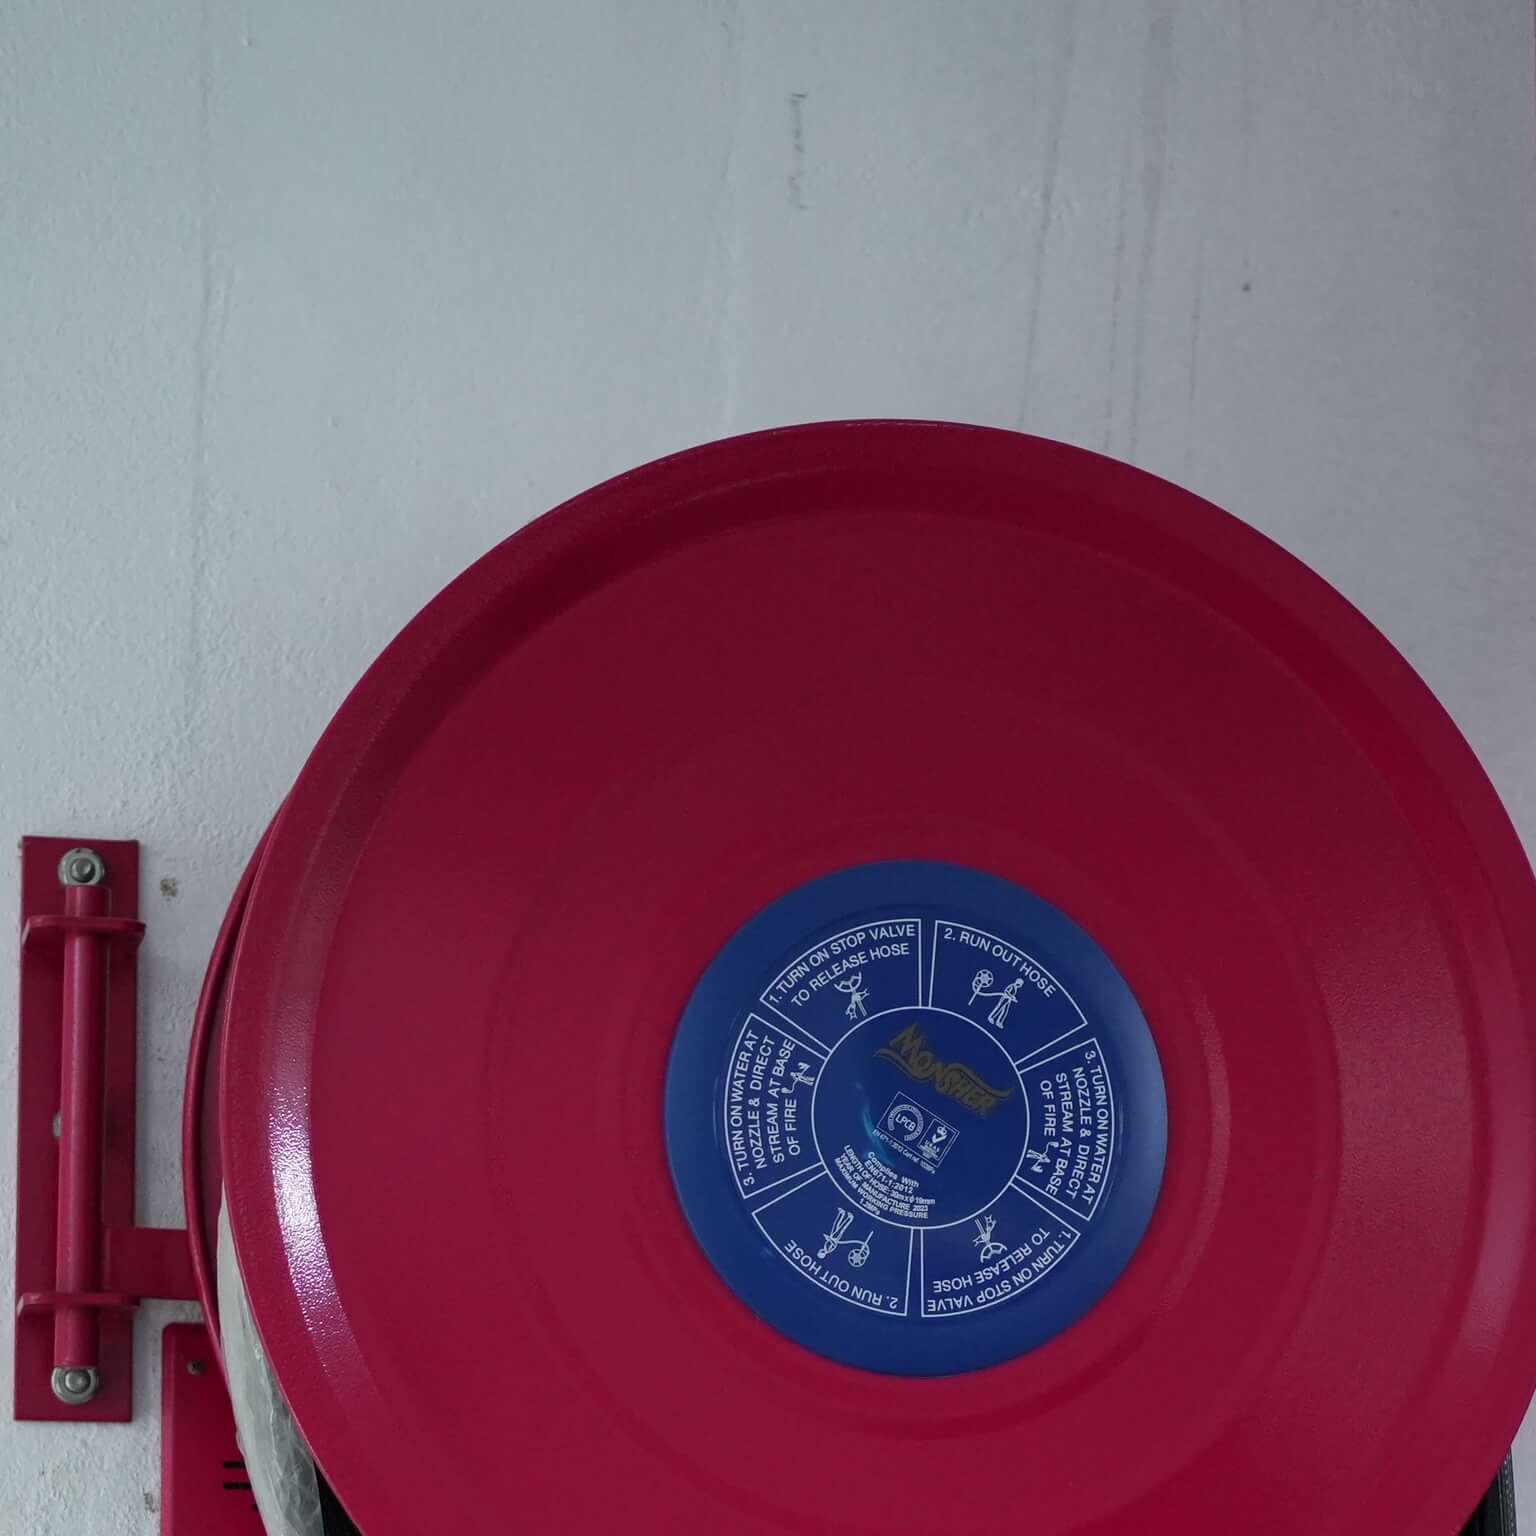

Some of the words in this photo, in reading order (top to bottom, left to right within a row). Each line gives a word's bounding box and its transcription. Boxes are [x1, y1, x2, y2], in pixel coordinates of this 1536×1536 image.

[769, 993, 783, 1004] 1.
[776, 961, 810, 994] TURN
[809, 948, 830, 967] ON
[830, 931, 866, 955] STOP
[869, 924, 915, 941] VALVE
[791, 989, 810, 1007] TO
[809, 952, 869, 991] RELEASE
[869, 943, 910, 961] HOSE
[944, 927, 956, 941] 2.
[959, 931, 991, 951] RUN
[992, 944, 1022, 967] OUT
[1019, 961, 1057, 998] HOSE
[744, 1029, 759, 1051] AT
[750, 1035, 775, 1091] DIRECT
[774, 1039, 796, 1077] BASE
[1084, 1050, 1096, 1064] 3.
[730, 1051, 752, 1104] WATER
[768, 1079, 782, 1099] AT
[1040, 1080, 1055, 1100] OF
[1090, 1065, 1107, 1106] TURN
[748, 1097, 760, 1107] &
[1055, 1073, 1074, 1133] STREAM
[1072, 1066, 1092, 1126] NOZZLE
[730, 1105, 743, 1128] ON
[784, 1099, 797, 1131] FIRE
[895, 1112, 917, 1132] LPCB
[1043, 1104, 1056, 1137] FIRE
[1096, 1108, 1109, 1130] ON
[748, 1109, 768, 1169] NOZZLE
[766, 1103, 785, 1163] STREAM
[787, 1139, 801, 1156] OF
[1059, 1136, 1072, 1157] AT
[1079, 1128, 1092, 1138] &
[731, 1130, 748, 1171] TURN
[844, 1144, 863, 1169] LENGTH
[861, 1169, 872, 1180] OF
[868, 1151, 898, 1180] Complies
[1087, 1133, 1109, 1184] WATER
[743, 1172, 755, 1186] 3.
[840, 1153, 855, 1173] YEAR
[853, 1172, 862, 1181] OF
[862, 1181, 911, 1211] MANUFACTURE
[1045, 1158, 1069, 1196] BASE
[1065, 1144, 1090, 1200] DIRECT
[834, 1157, 859, 1189] MAXIMUM
[857, 1188, 889, 1211] WORKING
[889, 1207, 928, 1219] PRESSURE
[1081, 1183, 1096, 1205] AT
[1031, 1227, 1050, 1245] TO
[1058, 1231, 1072, 1239] 1.
[784, 1239, 821, 1276] HOSE
[974, 1243, 1033, 1284] RELEASE
[1031, 1240, 1065, 1272] TURN
[819, 1270, 850, 1293] OUT
[933, 1275, 973, 1293] HOSE
[976, 1280, 1012, 1304] STOP
[1013, 1268, 1032, 1286] ON
[851, 1285, 883, 1306] RUN
[885, 1295, 898, 1309] 2.
[927, 1295, 974, 1312] VALVE
